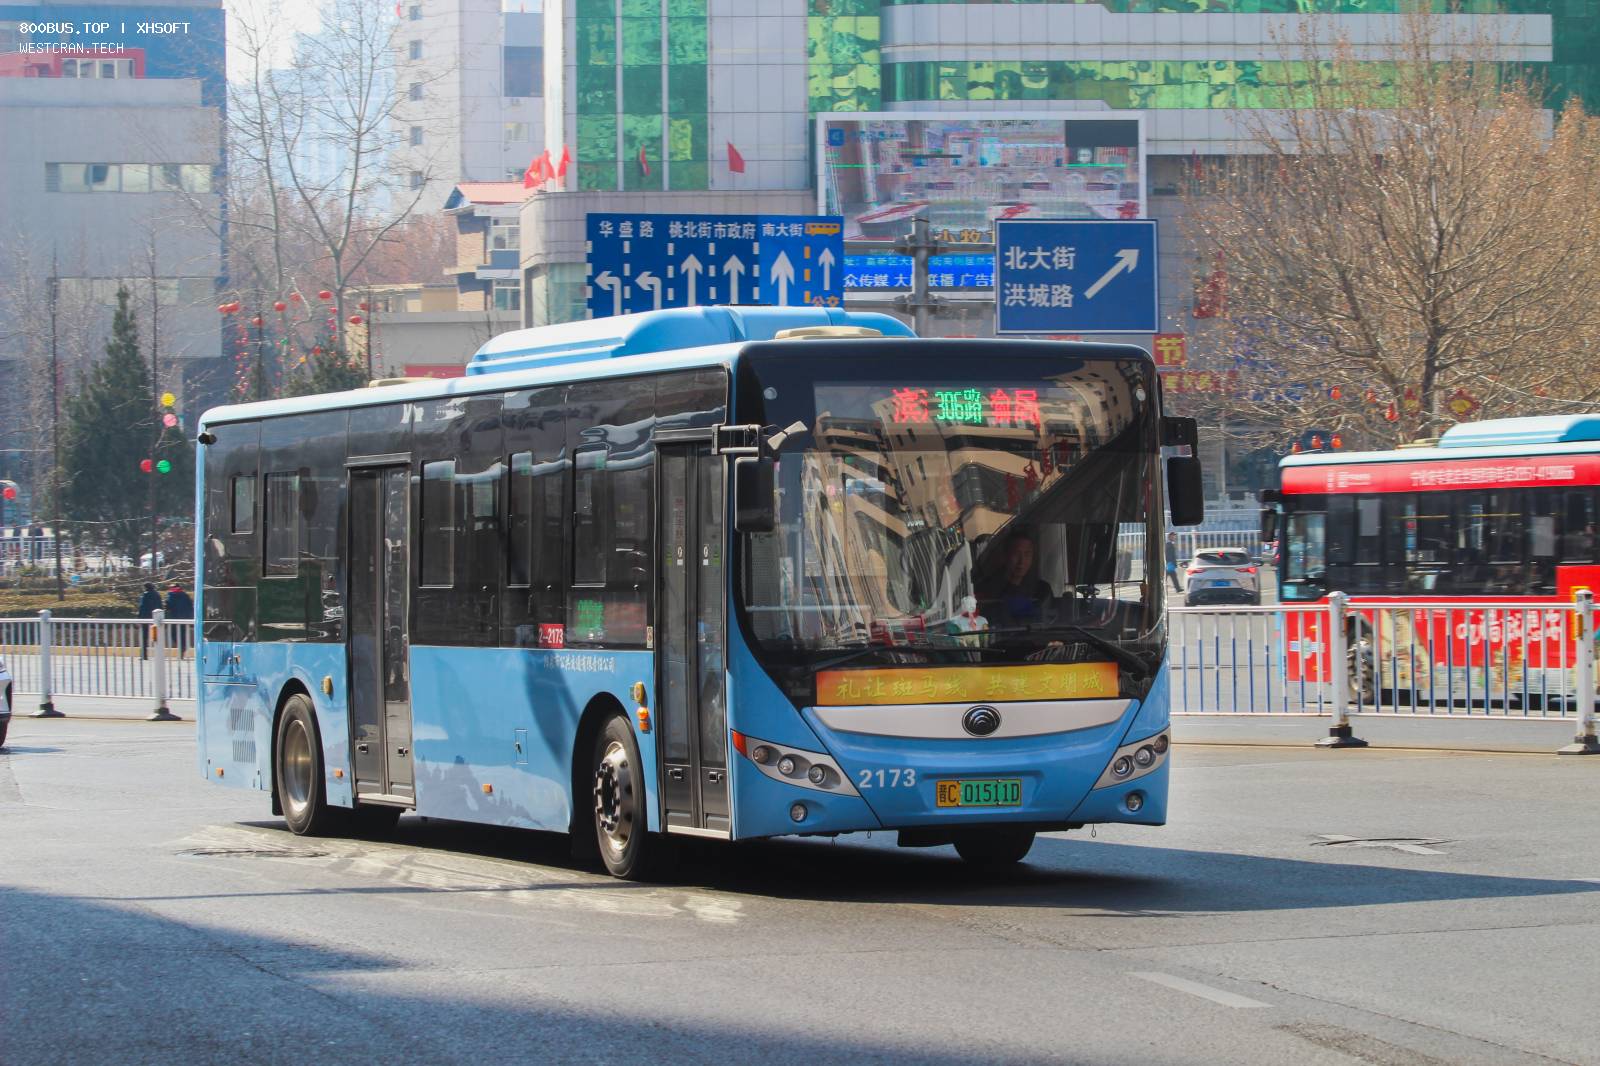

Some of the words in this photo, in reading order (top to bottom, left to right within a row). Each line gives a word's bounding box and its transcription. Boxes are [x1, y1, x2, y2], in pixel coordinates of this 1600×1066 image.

[599, 221, 654, 239] 华盛路
[762, 223, 803, 238] 南大街
[1004, 246, 1076, 270] 北大街
[843, 273, 889, 287] 众传媒
[1004, 282, 1075, 308] 洪城路
[1155, 337, 1183, 364] 节
[935, 388, 982, 424] 306路
[835, 672, 968, 700] 礼让斑马线
[986, 670, 1105, 697] 共建文明城
[858, 768, 917, 789] 2173
